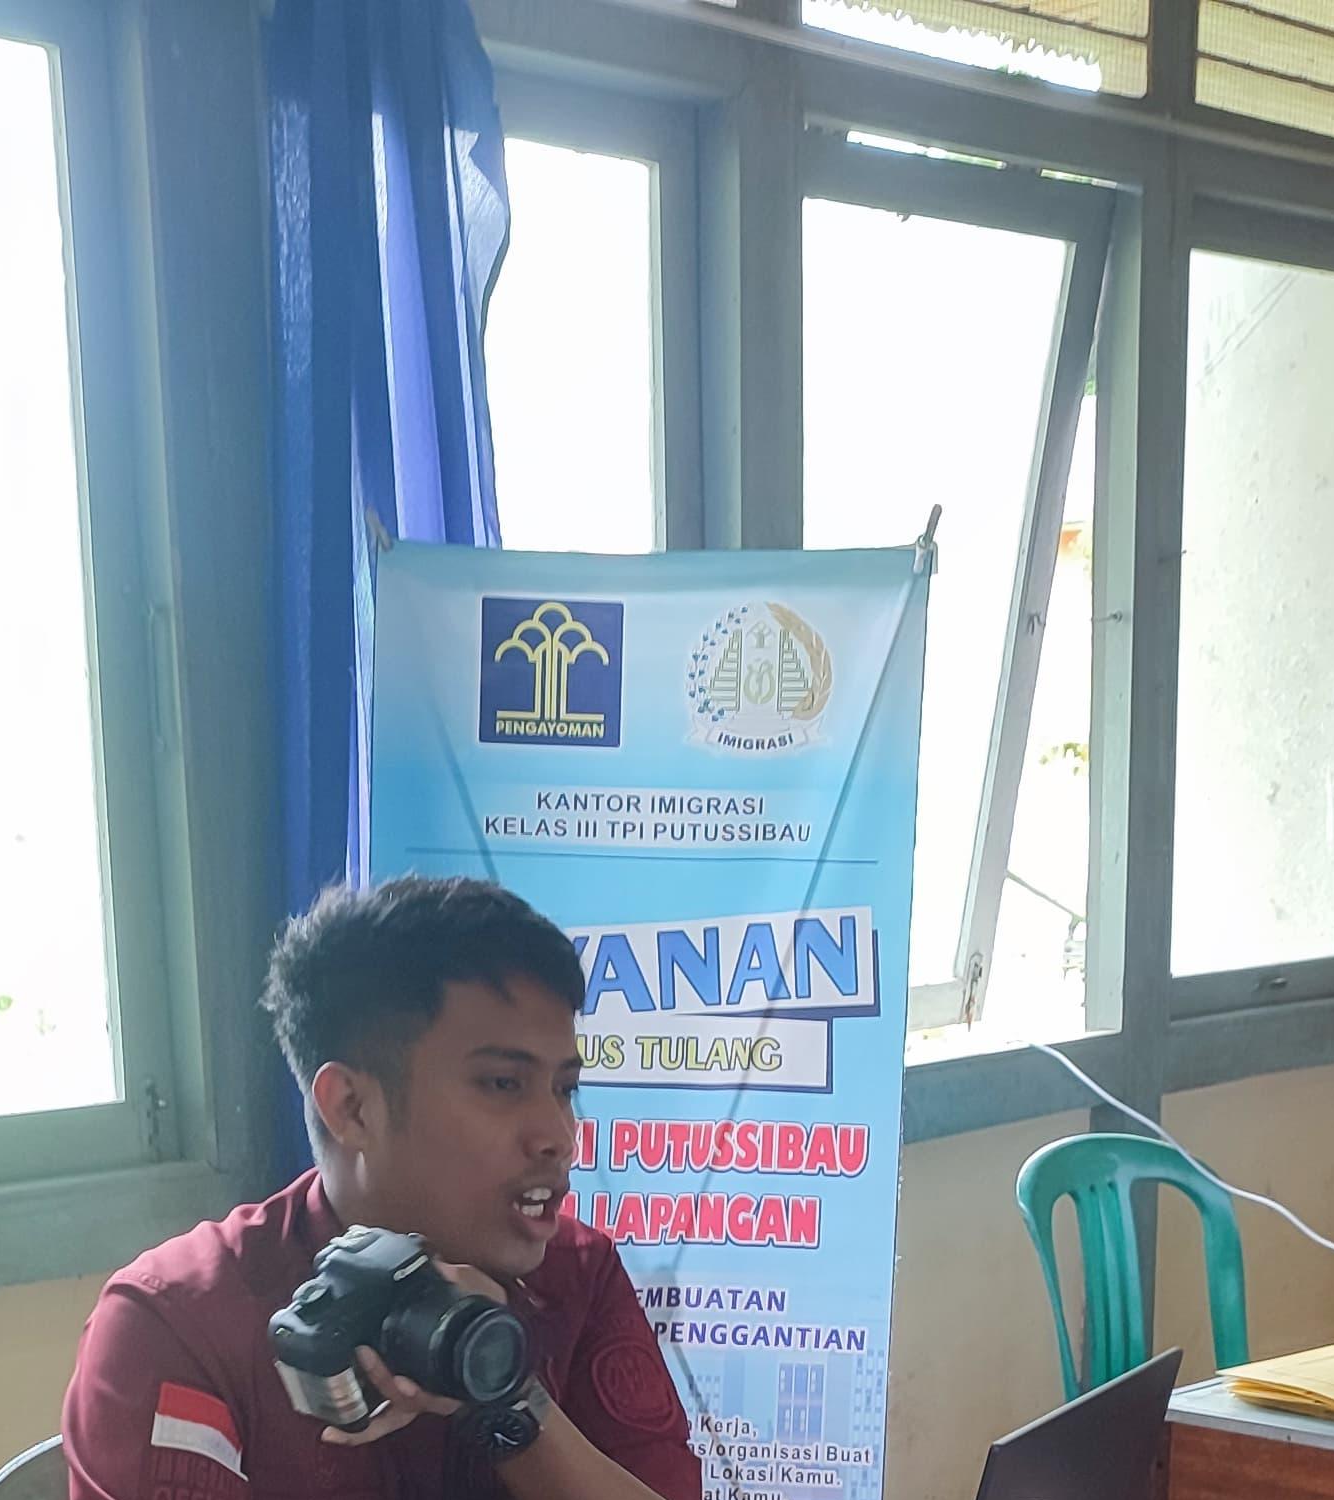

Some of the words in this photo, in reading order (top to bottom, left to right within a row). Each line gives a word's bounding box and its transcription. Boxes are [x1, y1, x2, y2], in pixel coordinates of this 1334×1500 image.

[496, 720, 605, 738] PENGAYOMAN
[717, 732, 794, 750] IMIGRASI
[537, 792, 642, 813] KANTOR
[650, 796, 764, 815] IMIGRASI
[485, 816, 567, 837] KELAS
[577, 819, 597, 838] III
[606, 821, 644, 840] TPI
[653, 822, 812, 842] PUTUSSIBAU
[576, 1034, 625, 1069] US
[635, 1037, 782, 1071] TULANG
[612, 1120, 868, 1175] PUTUSSIBAU
[593, 1192, 820, 1247] LAPANGAN
[654, 1322, 865, 1350] PENGGANTIAN
[700, 1415, 757, 1437] Kerja,
[827, 1446, 871, 1462] Buat
[710, 1464, 773, 1481] Lokasi
[782, 1467, 841, 1485] Kamu.
